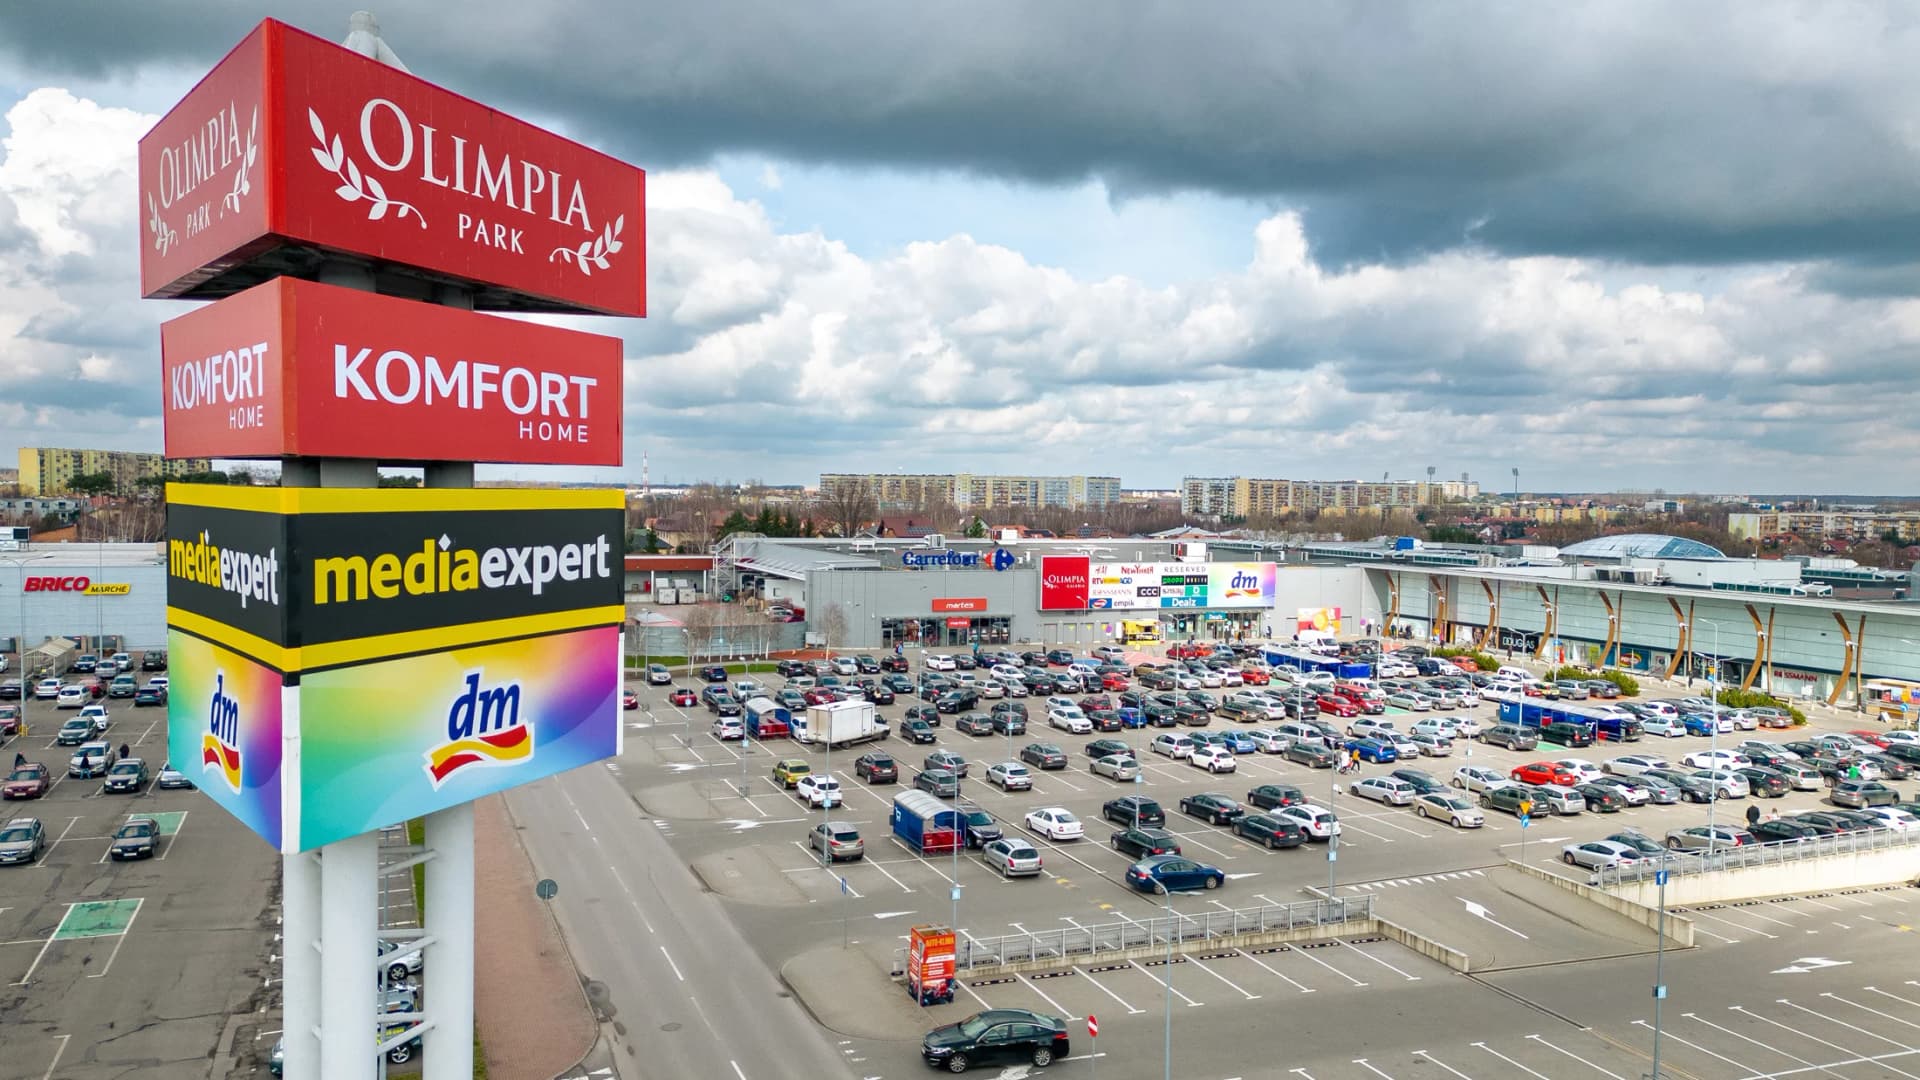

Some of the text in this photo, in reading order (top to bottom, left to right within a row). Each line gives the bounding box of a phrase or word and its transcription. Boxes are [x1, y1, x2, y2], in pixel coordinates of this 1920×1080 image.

[159, 100, 241, 208] OLIMPIA
[360, 99, 593, 233] OLIMPIA
[186, 201, 211, 239] PARK
[459, 213, 524, 254] PARK
[171, 342, 268, 410] KOMFORT
[334, 344, 597, 419] KOMFORT
[229, 405, 263, 429] HOME
[520, 421, 588, 443] HOME
[170, 529, 279, 608] mediaexpert
[314, 533, 610, 605] mediaexpert
[902, 551, 979, 566] Carrefour
[24, 576, 90, 592] BRICO
[1048, 574, 1085, 584] OLIMPIA
[1231, 571, 1257, 588] dm
[1114, 599, 1134, 607] empik
[1172, 597, 1197, 607] Dealz
[1503, 637, 1535, 649] DOUGAS
[210, 674, 239, 747] dm
[448, 673, 521, 741] dm
